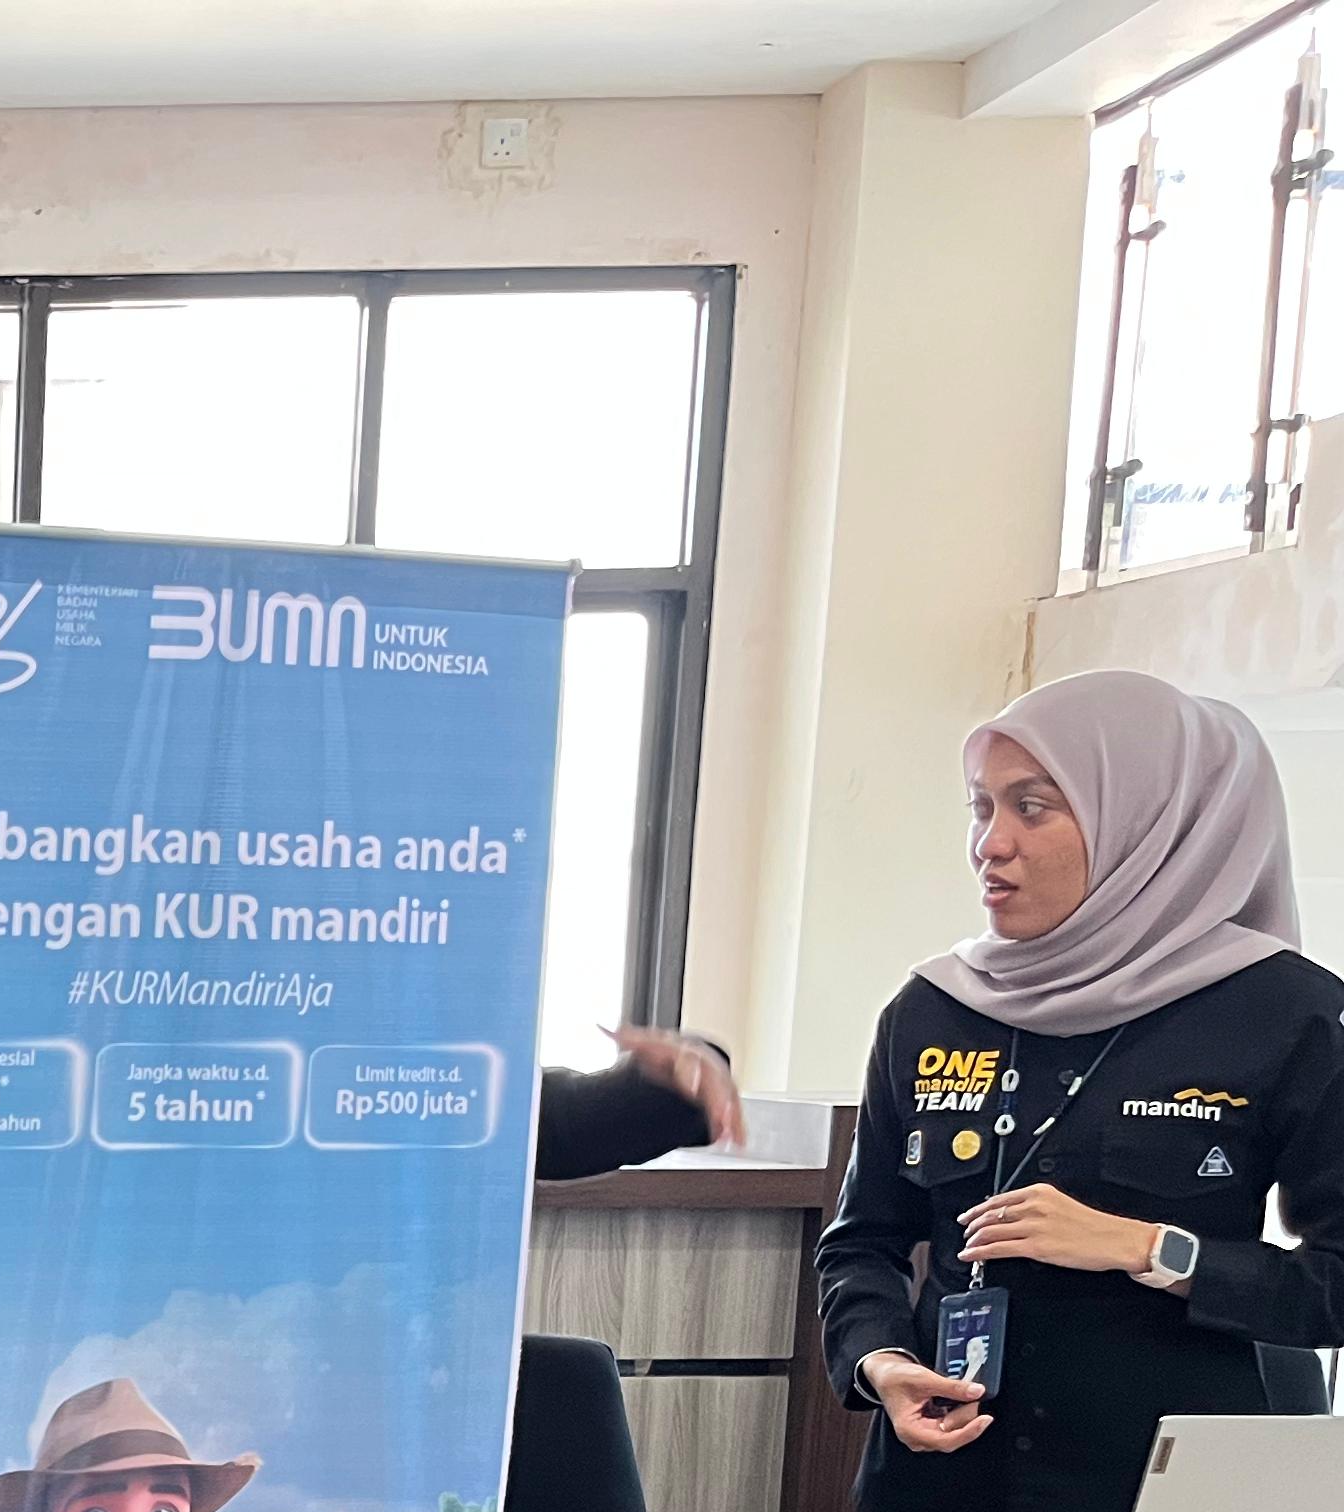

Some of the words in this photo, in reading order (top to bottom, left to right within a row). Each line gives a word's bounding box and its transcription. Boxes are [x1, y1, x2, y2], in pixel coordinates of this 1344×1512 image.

[56, 596, 98, 608] BADAN
[56, 609, 97, 621] USAHA
[55, 622, 88, 634] MILIK
[374, 623, 449, 649] UNTUK
[54, 635, 102, 647] NEGARA
[372, 650, 490, 676] INDONESIA
[238, 820, 382, 871] usaha
[154, 892, 258, 942] KUR
[270, 898, 450, 946] mandiri
[67, 970, 335, 1016] #KURMandiriAja
[355, 1064, 394, 1083] Limit
[398, 1064, 436, 1083] kredit
[438, 1066, 463, 1083] s.d.
[918, 1047, 1000, 1078] ONE
[126, 1063, 183, 1086] Jangka
[186, 1063, 238, 1082] waktu
[242, 1064, 270, 1081] s.d.
[915, 1077, 992, 1094] mandiri
[128, 1094, 146, 1121] 5
[336, 1090, 414, 1117] Rp500
[914, 1092, 985, 1112] TEAM
[1123, 1098, 1222, 1121] mandiri
